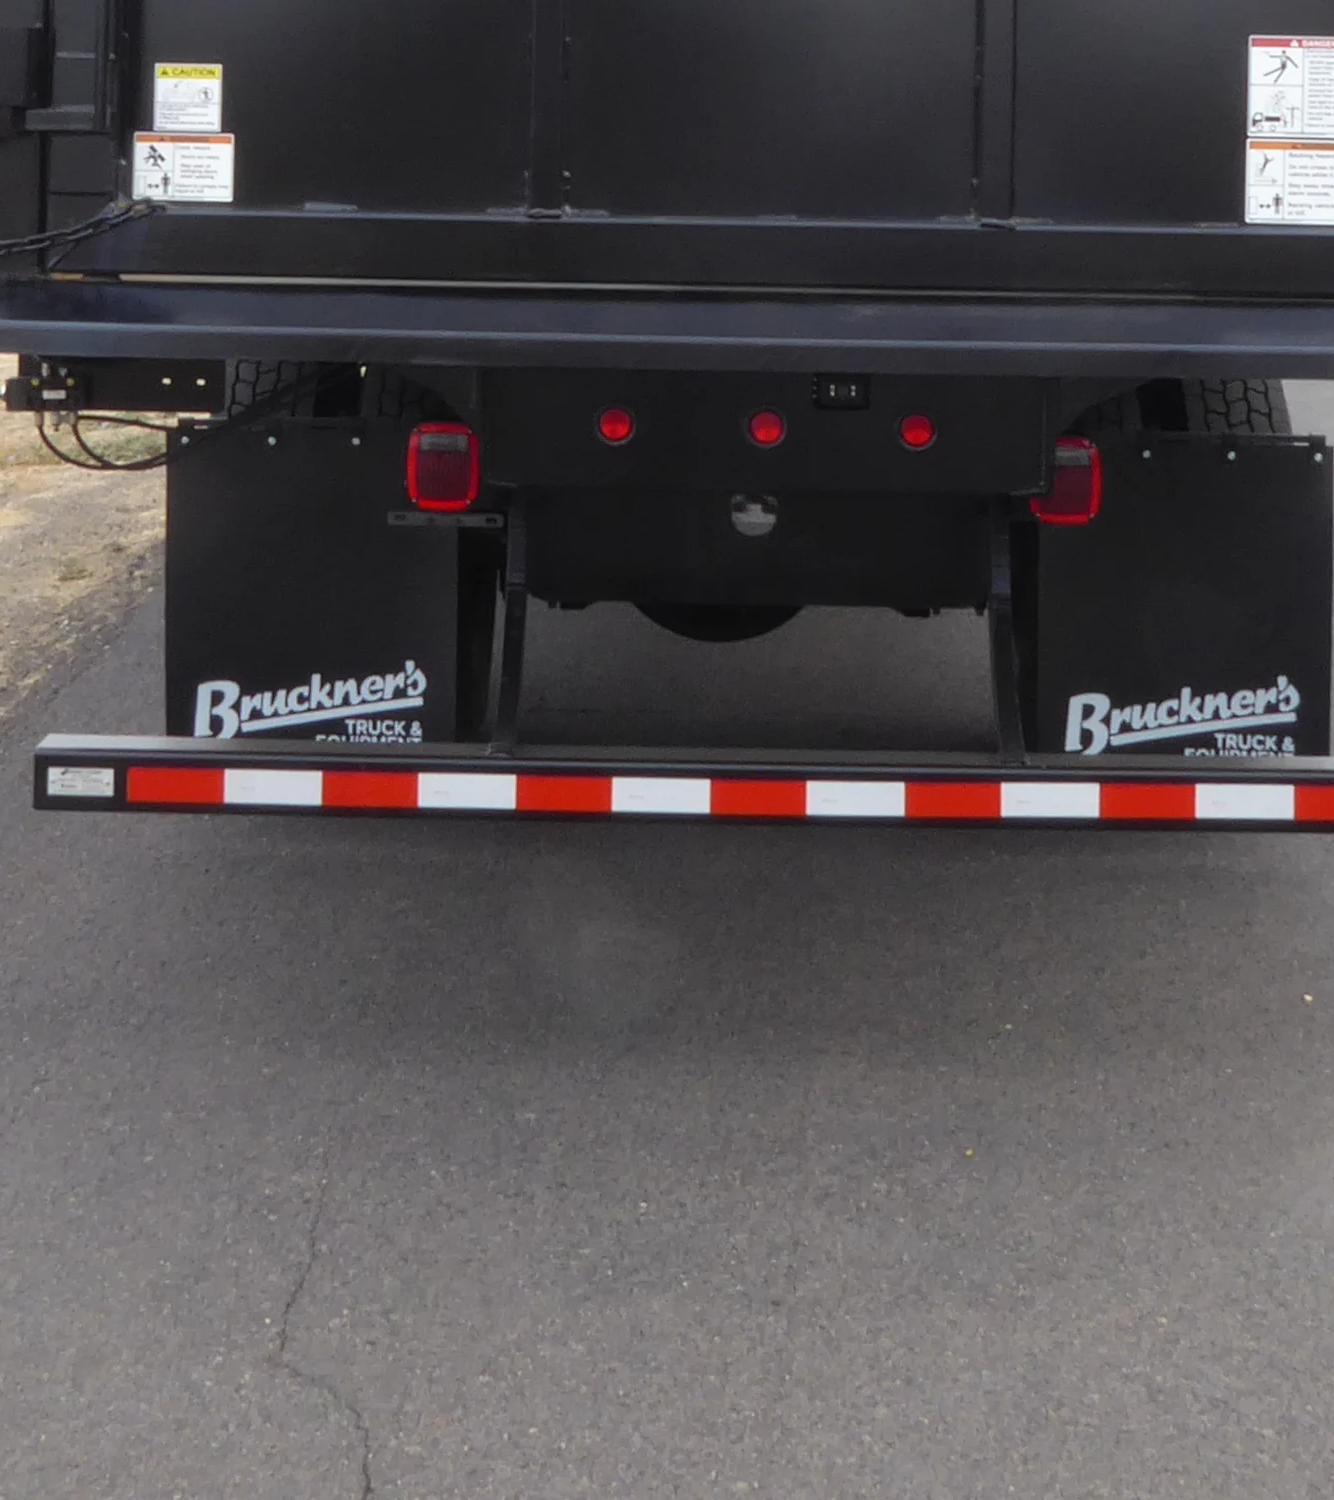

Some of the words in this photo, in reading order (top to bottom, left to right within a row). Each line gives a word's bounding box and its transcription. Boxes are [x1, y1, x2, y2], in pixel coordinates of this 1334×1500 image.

[171, 67, 216, 77] CAUTION
[194, 659, 427, 740] Bruckner's
[1064, 675, 1300, 756] Bruckner's
[345, 719, 405, 736] TRUCK
[410, 720, 422, 736] &
[1214, 733, 1278, 751] TRUCK
[1282, 736, 1295, 751] &
